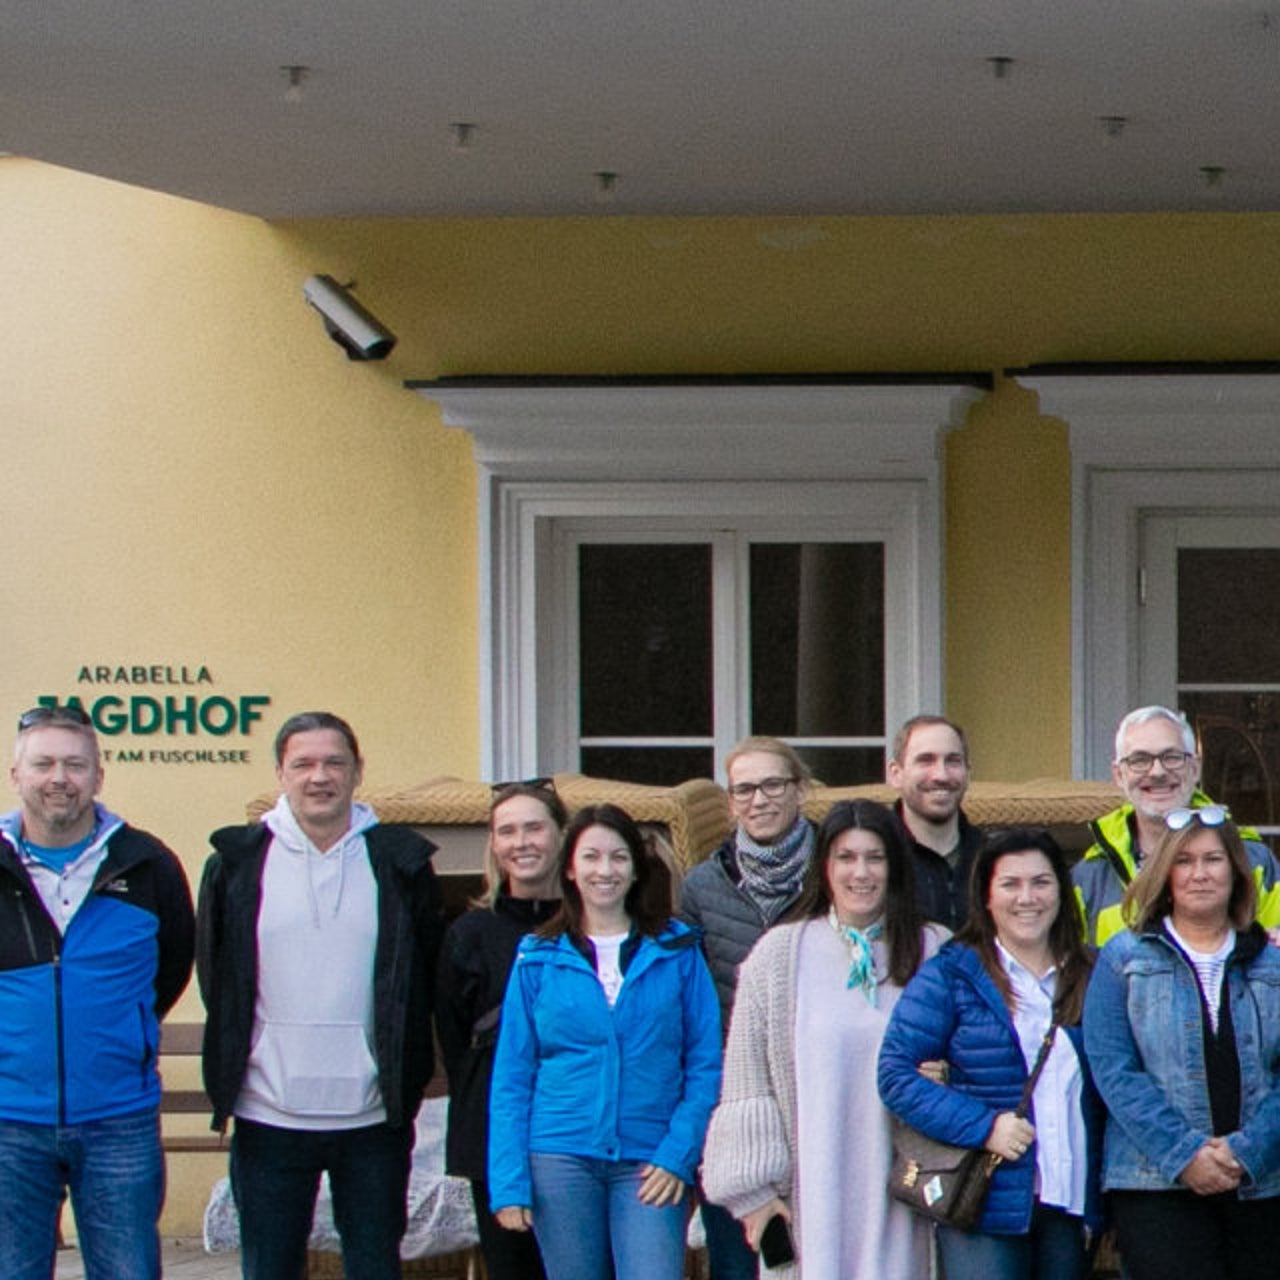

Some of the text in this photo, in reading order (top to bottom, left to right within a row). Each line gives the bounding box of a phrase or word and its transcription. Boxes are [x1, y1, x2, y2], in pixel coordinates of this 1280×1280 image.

[77, 665, 214, 685] ARABELLA
[117, 750, 144, 762] AM
[149, 749, 250, 763] FUSCHLSEE
